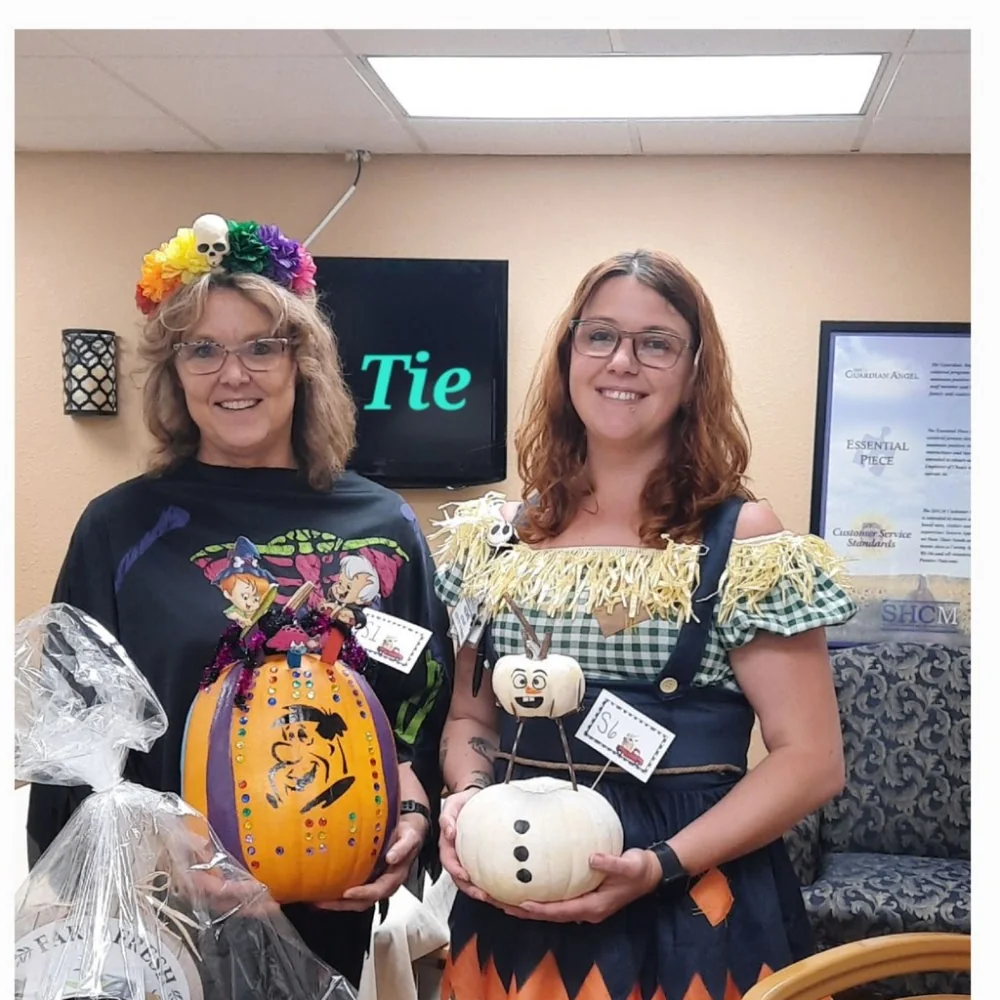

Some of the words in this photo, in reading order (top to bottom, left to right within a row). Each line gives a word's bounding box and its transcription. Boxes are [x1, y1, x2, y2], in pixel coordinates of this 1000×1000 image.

[846, 439, 910, 452] ESSENTIAL
[860, 454, 895, 466] PIECE
[832, 527, 877, 538] Customer
[878, 529, 912, 539] Service
[846, 538, 896, 549] Standards
[882, 603, 959, 626] SHCM
[595, 711, 619, 740] S6
